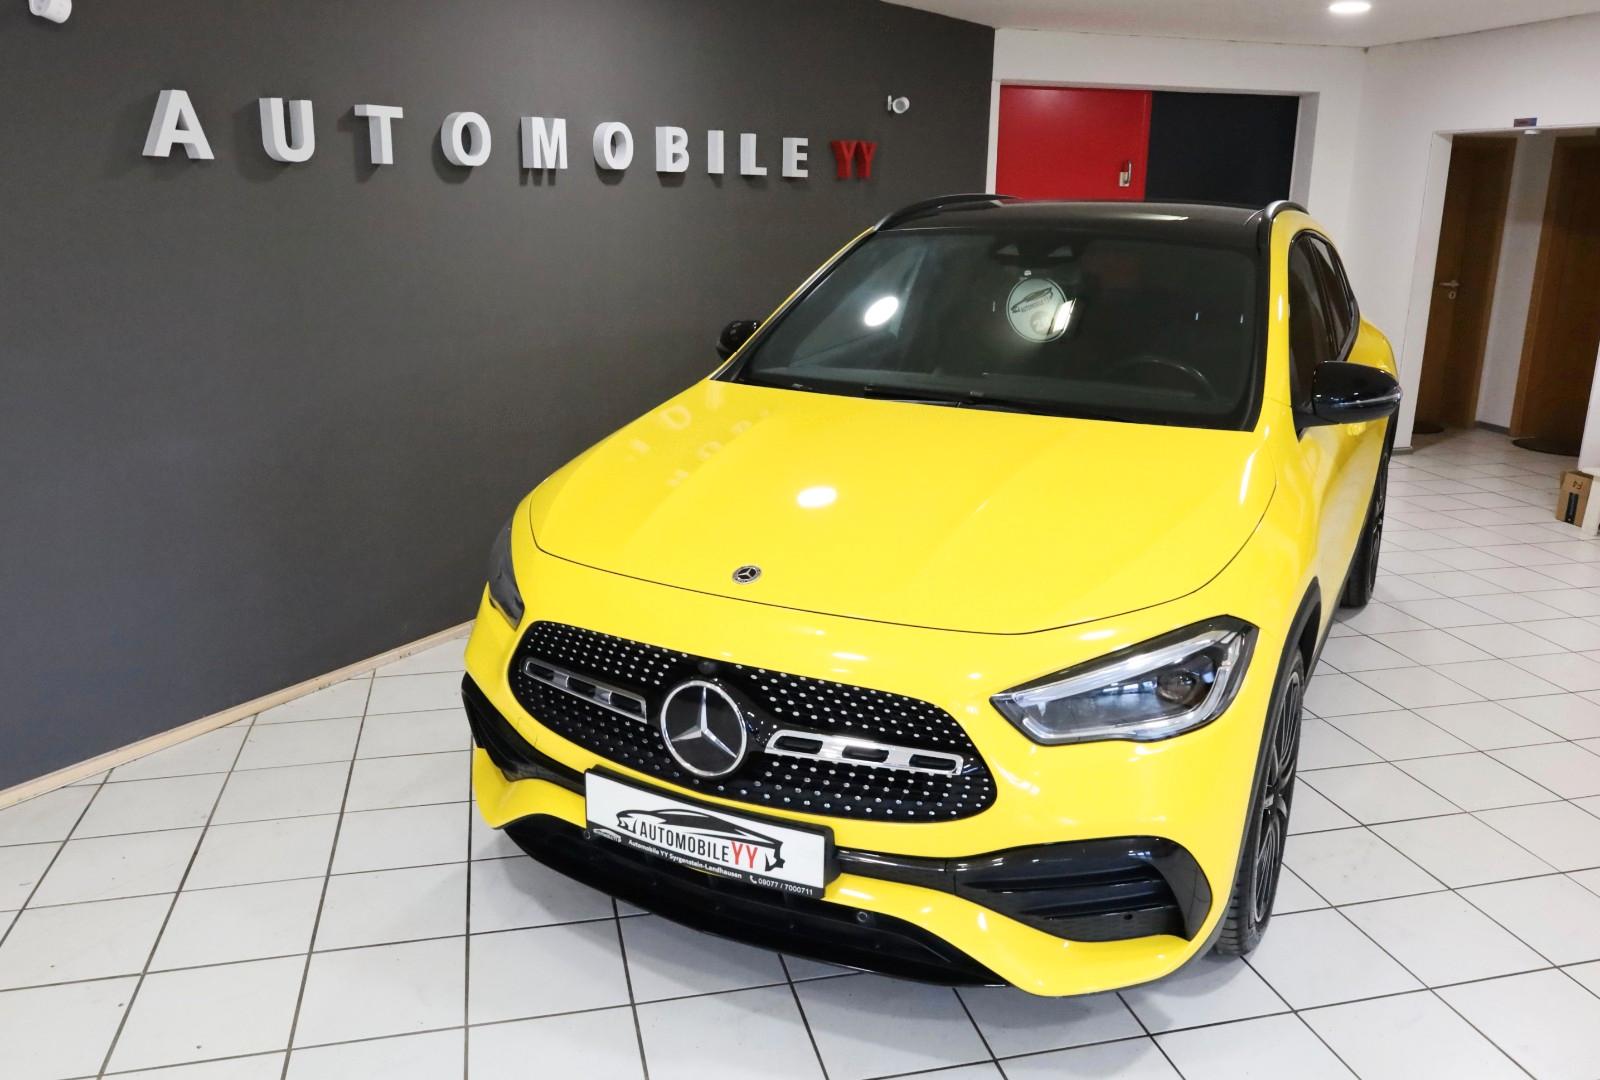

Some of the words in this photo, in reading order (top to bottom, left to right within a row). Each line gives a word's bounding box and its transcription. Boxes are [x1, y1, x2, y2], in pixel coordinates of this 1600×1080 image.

[141, 88, 810, 179] AUTOMOBILE
[832, 139, 877, 180] YY
[628, 839, 660, 855] Automobile
[784, 884, 814, 896] 7000711
